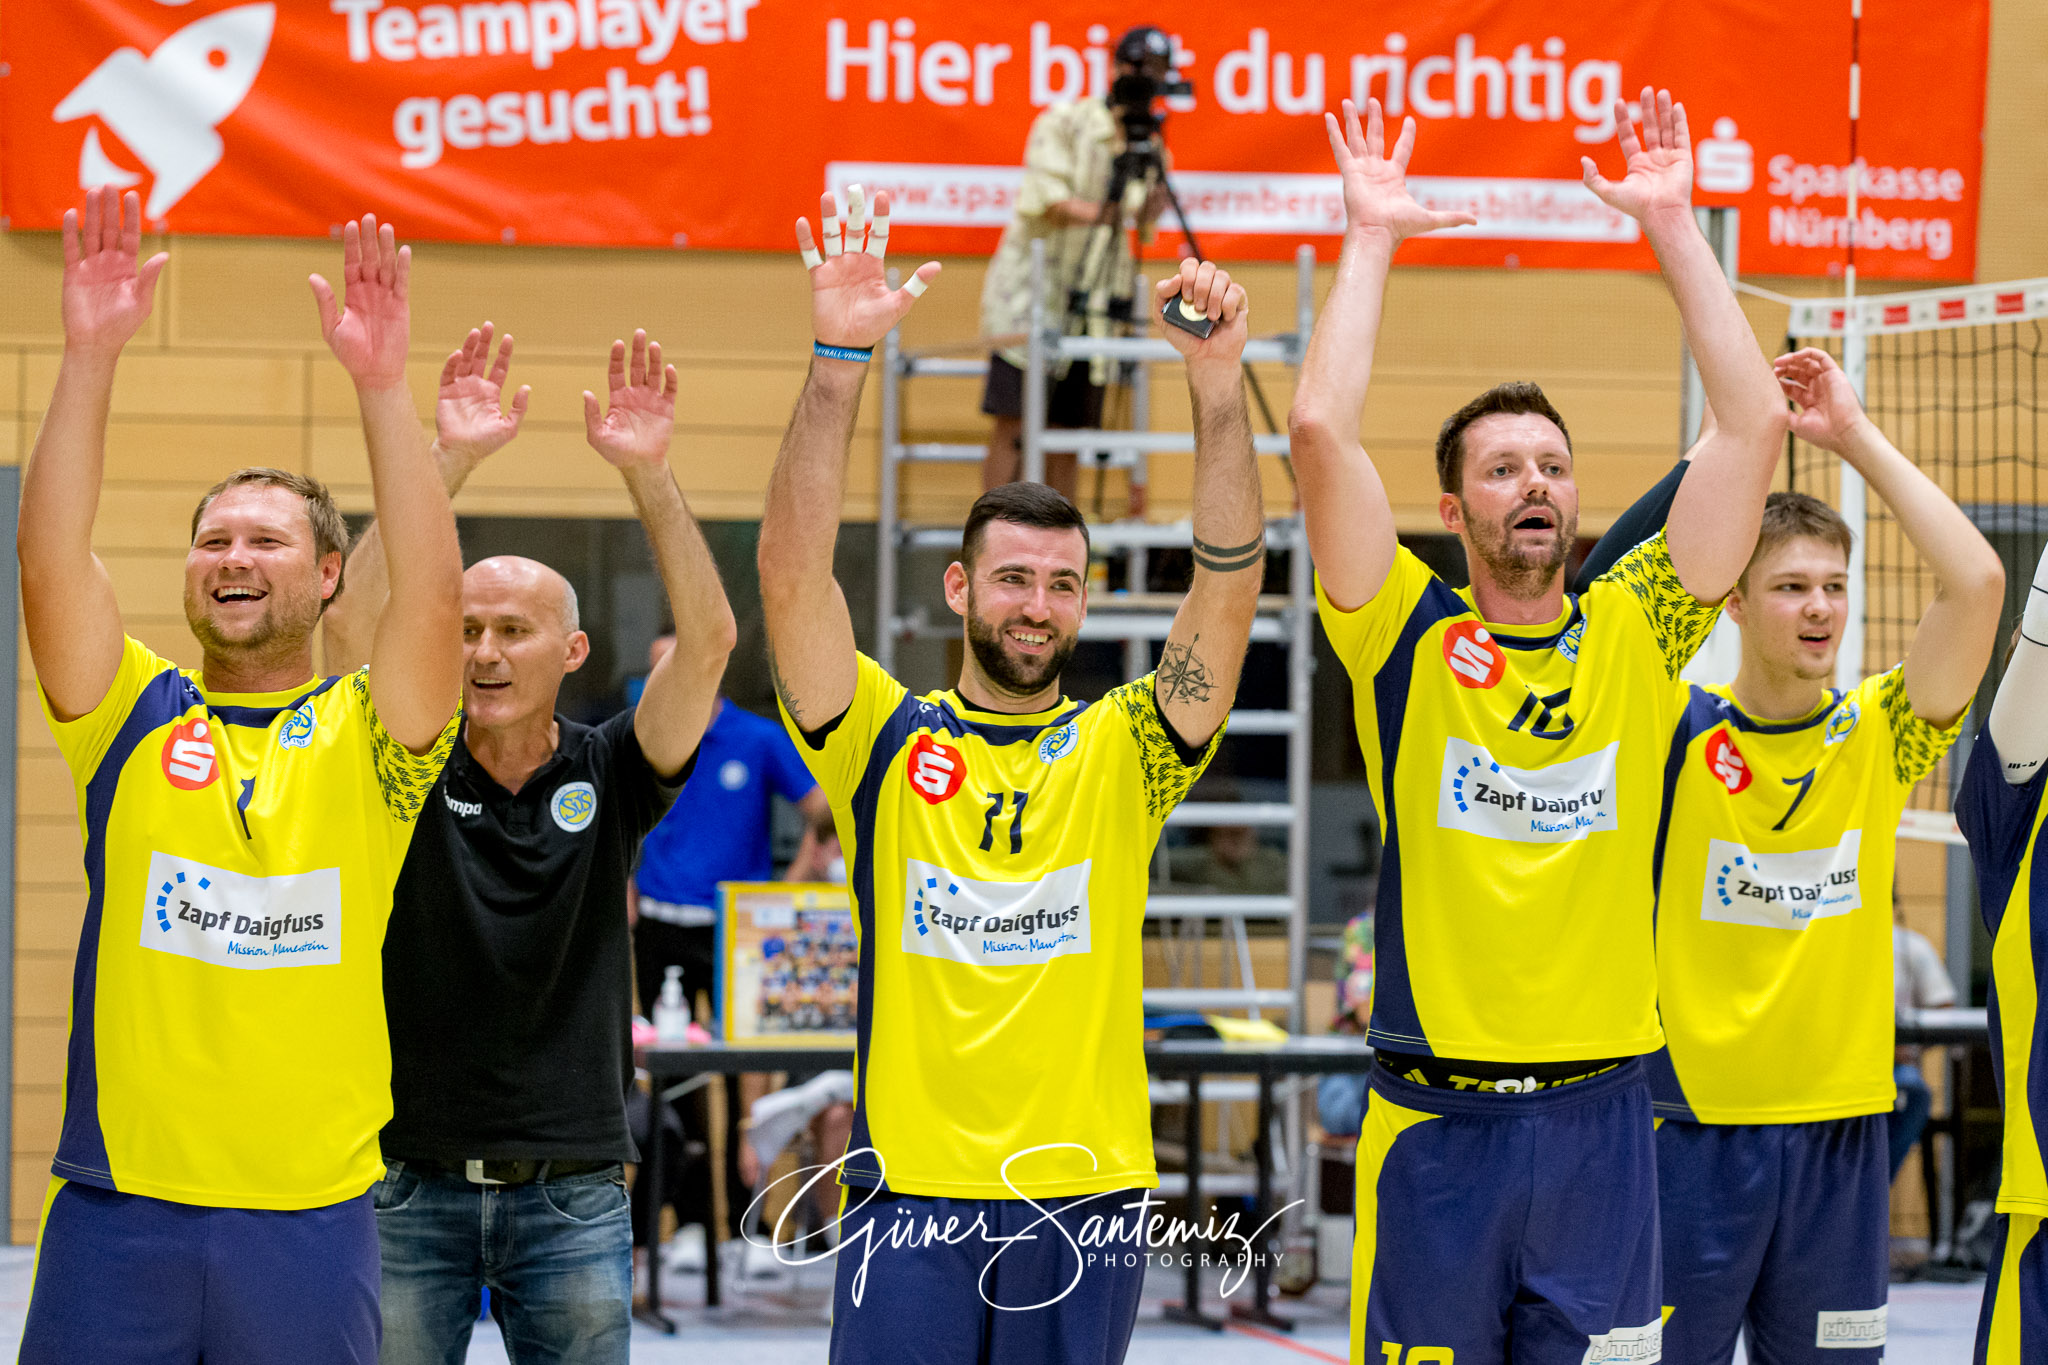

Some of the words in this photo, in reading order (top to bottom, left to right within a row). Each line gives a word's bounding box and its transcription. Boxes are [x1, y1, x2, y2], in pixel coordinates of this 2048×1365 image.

[330, 0, 760, 69] Teamplayer
[826, 18, 1012, 108] Hier
[1029, 21, 1198, 112] bit
[1214, 28, 1325, 116] du
[393, 65, 712, 169] gesucht!
[1767, 154, 1965, 204] Sparkasse
[1769, 205, 1953, 260] Nürnberg
[1474, 782, 1526, 812] Zapf
[1531, 787, 1607, 816] Daigfu
[1771, 767, 1816, 831] 7
[1737, 880, 1784, 903] Zapf
[177, 900, 231, 932] Zapf
[233, 913, 324, 940] Daigfuss
[929, 905, 982, 935] Zapf
[983, 904, 1080, 935] Daigfuss
